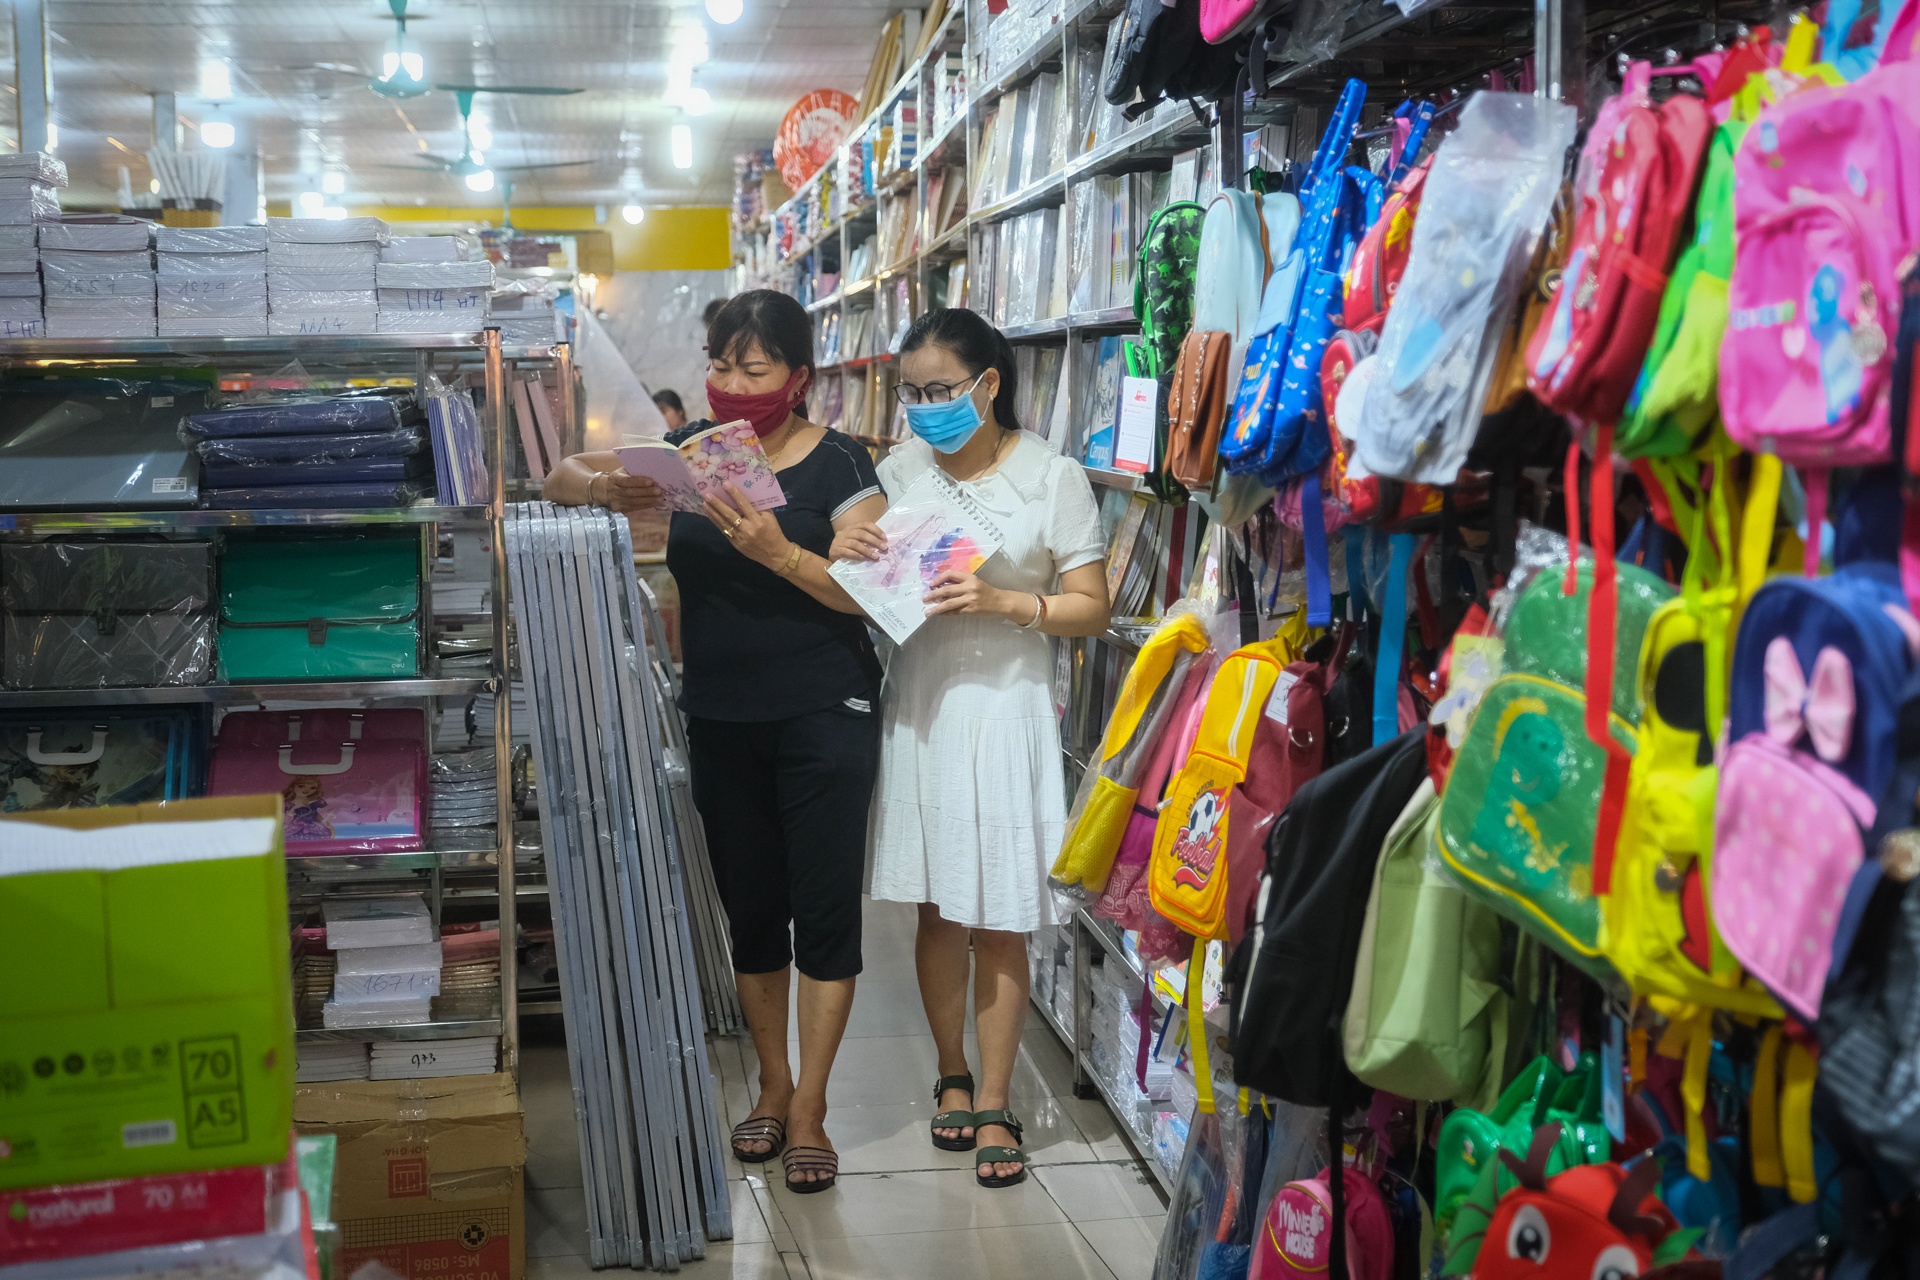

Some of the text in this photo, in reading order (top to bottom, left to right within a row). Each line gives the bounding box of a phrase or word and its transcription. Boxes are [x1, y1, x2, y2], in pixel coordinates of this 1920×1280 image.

[1089, 441, 1109, 463] Campus
[363, 974, 415, 994] 1671
[188, 1049, 232, 1081] 70
[194, 1097, 238, 1130] A5
[27, 1190, 115, 1223] natural
[143, 1184, 174, 1209] 70
[1286, 1231, 1315, 1259] MOUSE
[414, 1257, 449, 1272] 0586
[453, 1254, 480, 1267] MS:
